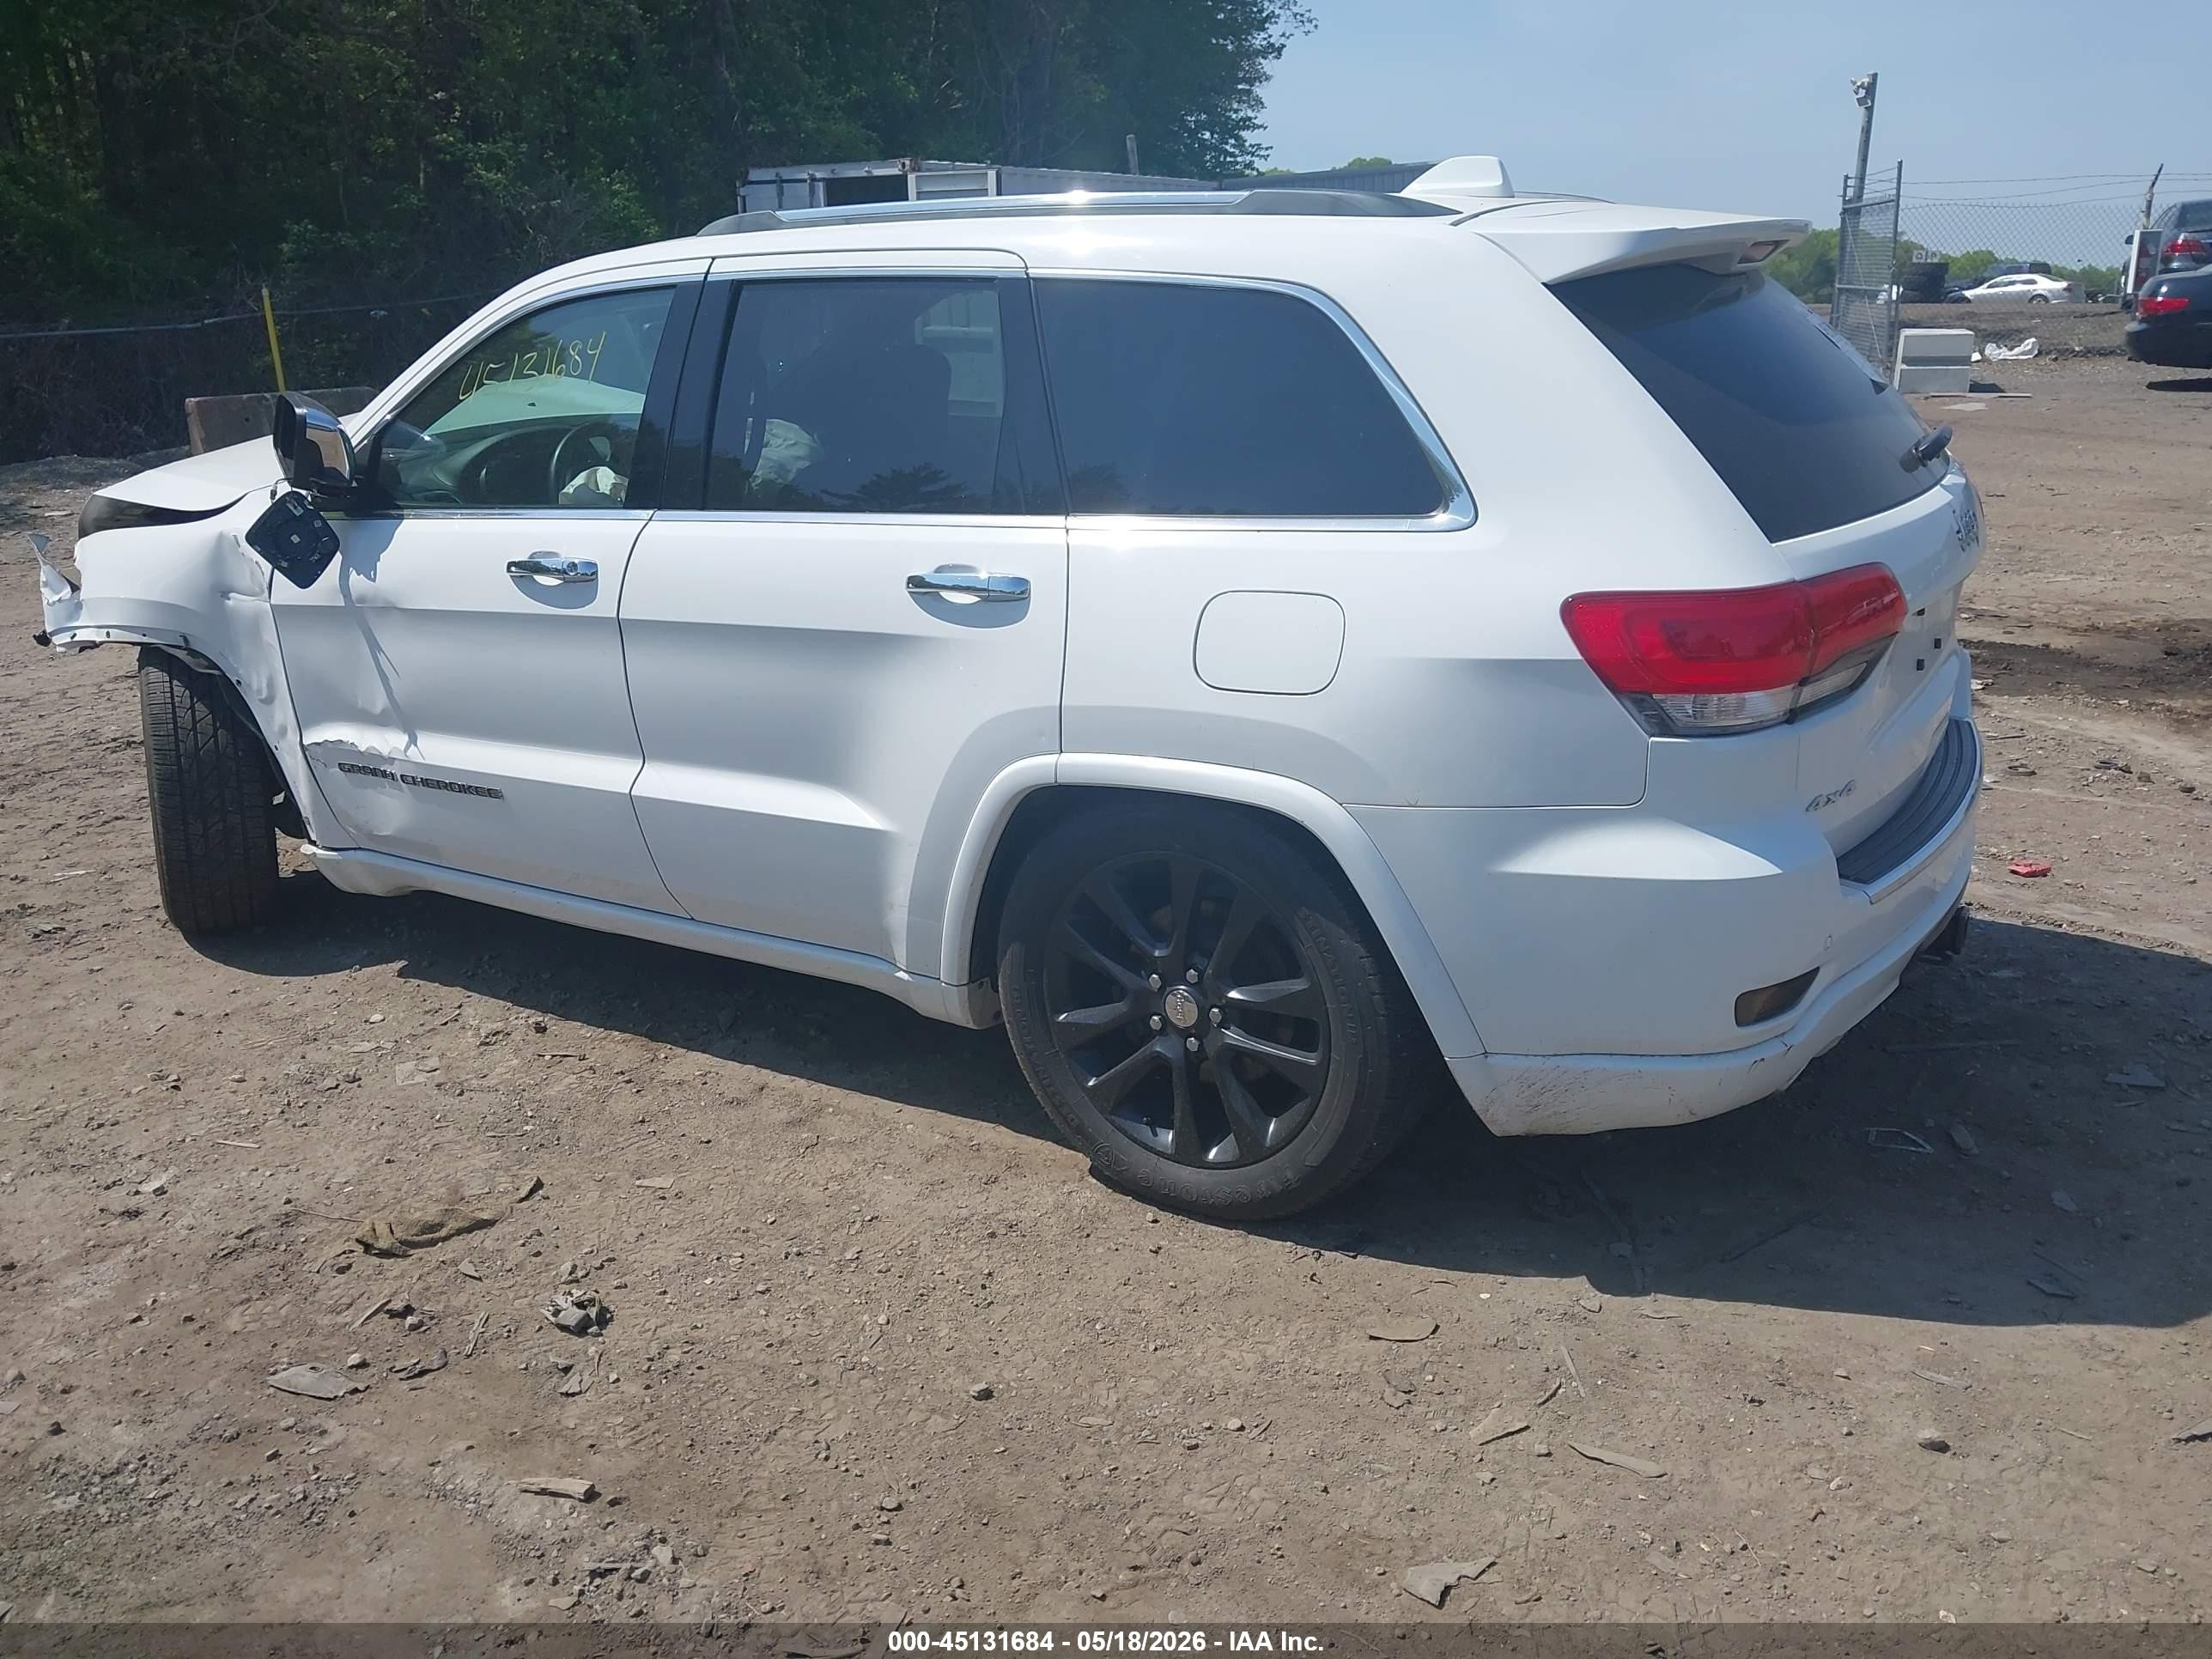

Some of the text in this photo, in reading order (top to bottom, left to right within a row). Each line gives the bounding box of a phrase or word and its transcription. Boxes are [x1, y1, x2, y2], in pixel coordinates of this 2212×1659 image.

[459, 331, 606, 399] 45131684
[337, 762, 504, 800] GRAND CHEROKEE
